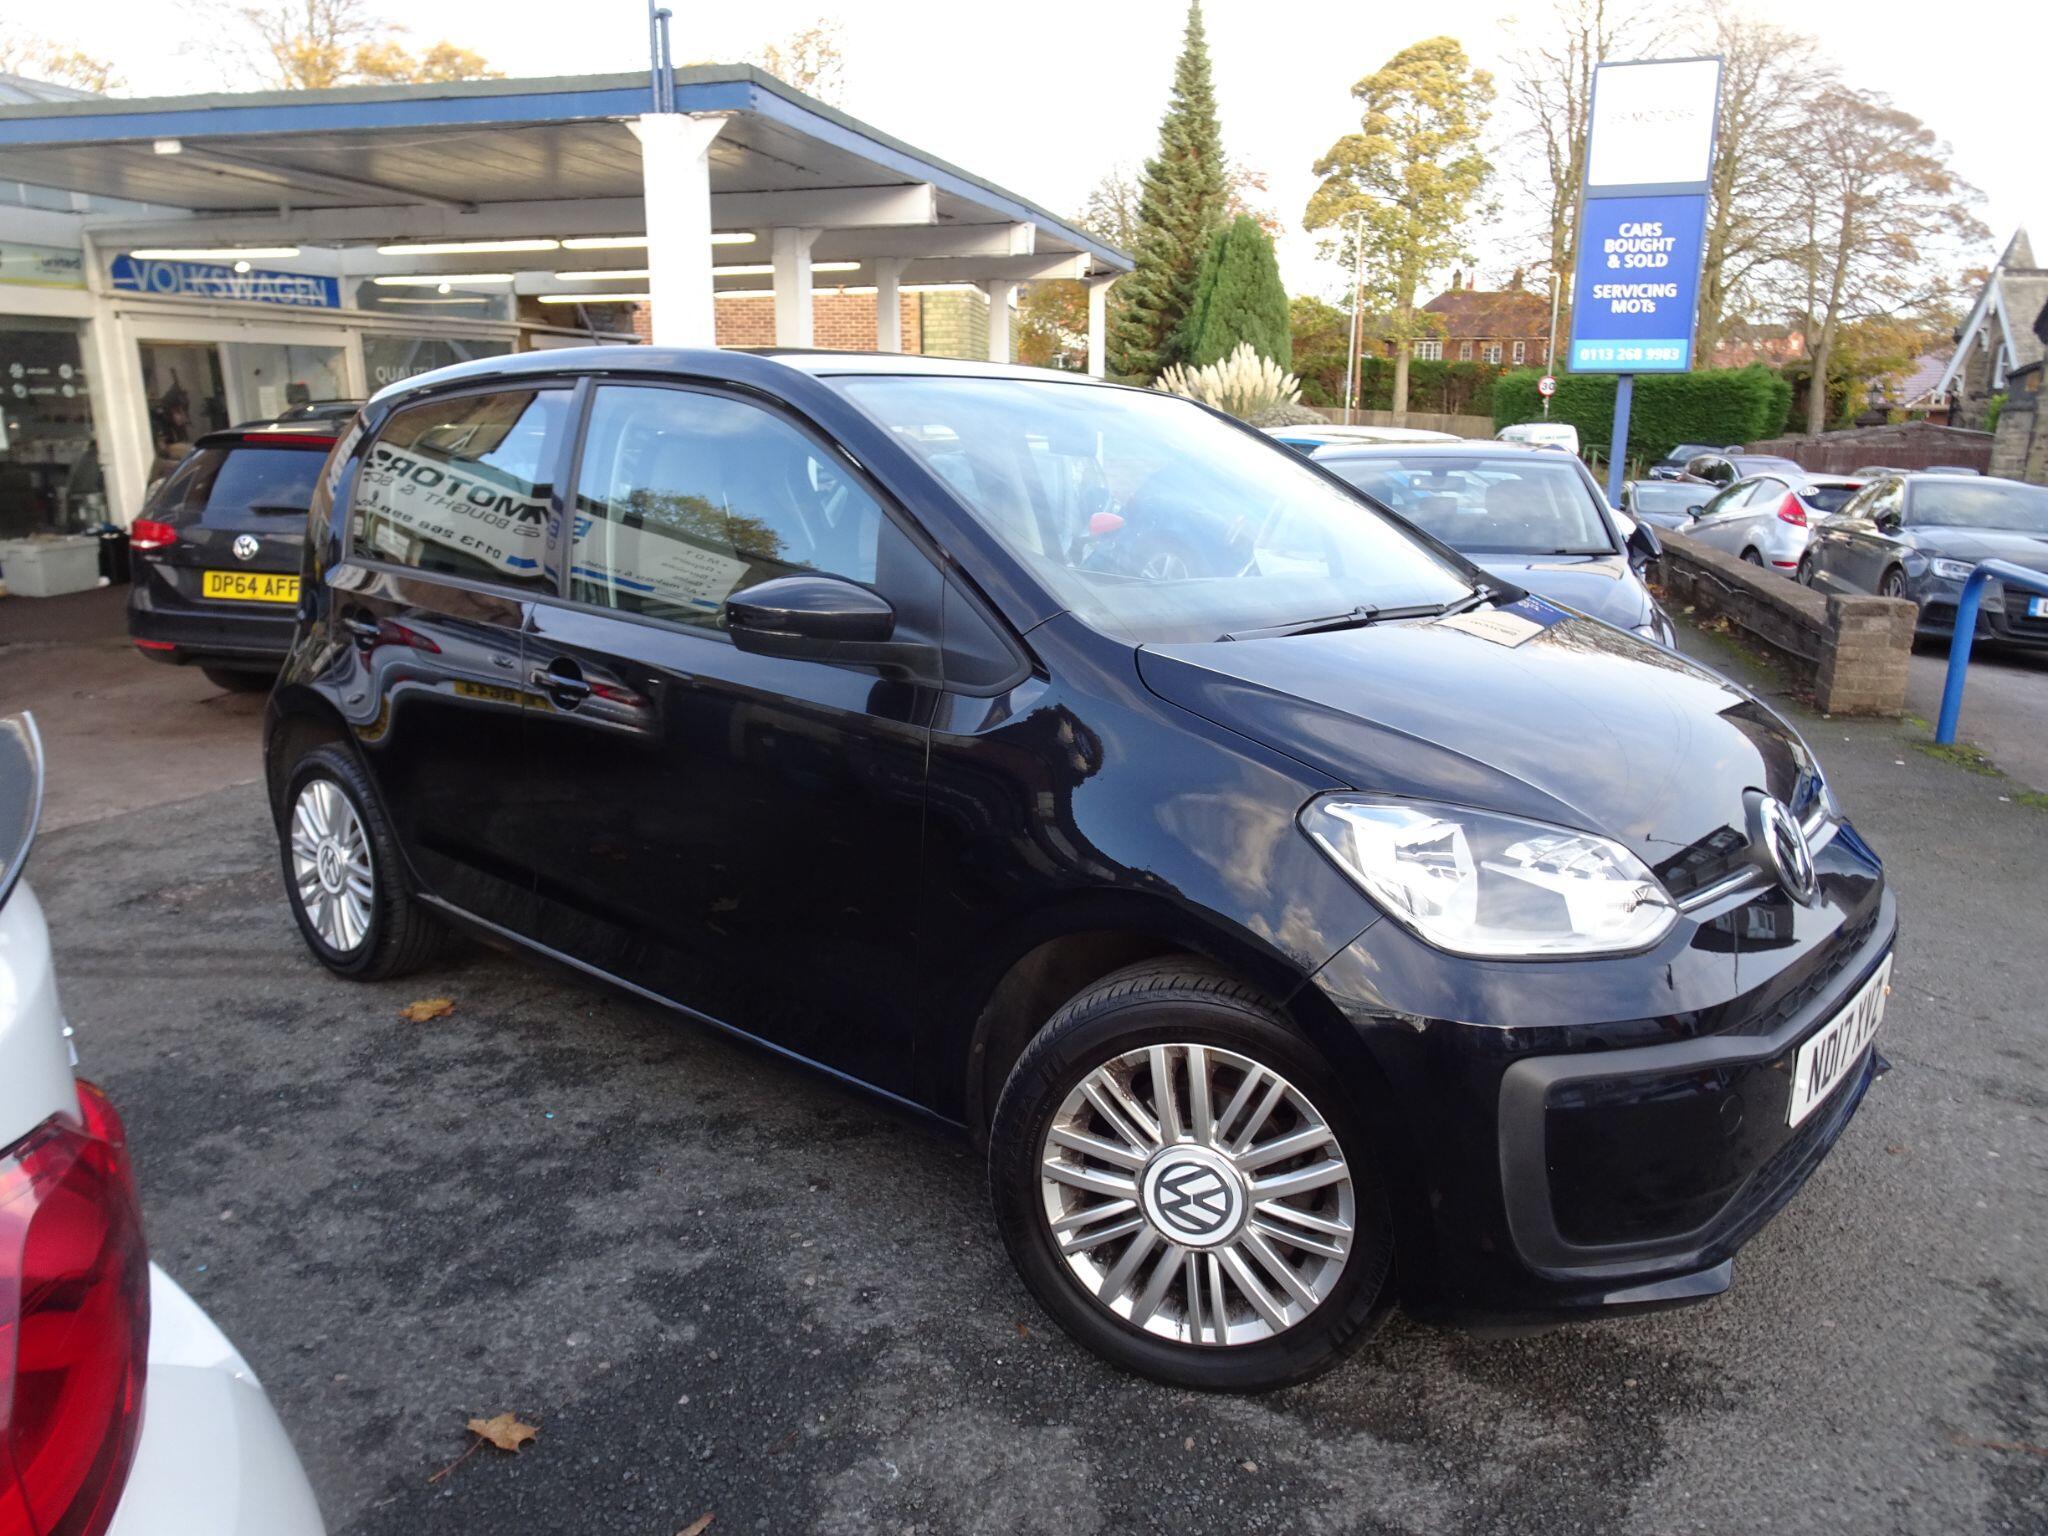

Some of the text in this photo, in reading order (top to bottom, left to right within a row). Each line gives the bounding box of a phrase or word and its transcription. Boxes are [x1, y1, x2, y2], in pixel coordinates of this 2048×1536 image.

[1619, 222, 1662, 237] CARS
[1604, 237, 1676, 253] BOUGHT
[1607, 253, 1669, 269] & SOLD
[129, 259, 328, 306] VOLKSWAGEN
[1592, 283, 1678, 299] SERVICING
[1611, 299, 1656, 313] MOTs
[1580, 347, 1614, 361] 0113
[1541, 382, 1556, 391] 30
[211, 574, 299, 597] DP64 AFF
